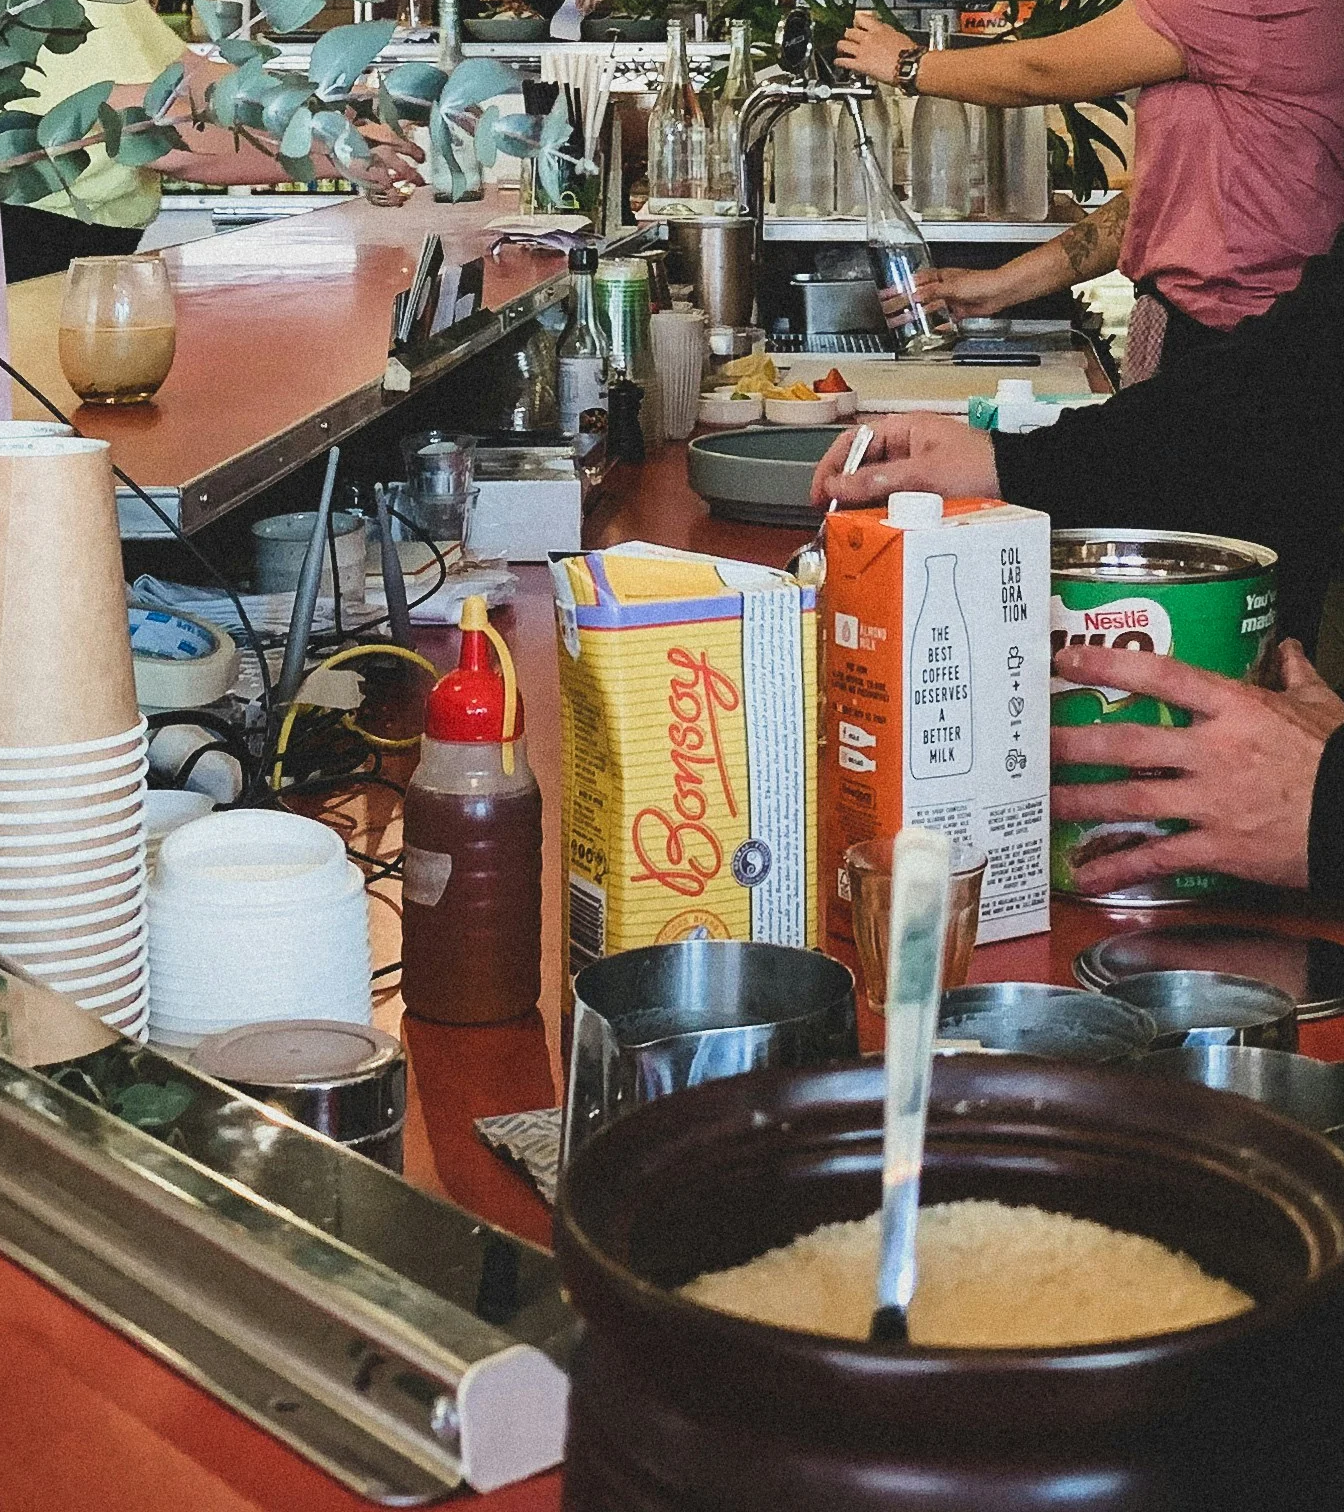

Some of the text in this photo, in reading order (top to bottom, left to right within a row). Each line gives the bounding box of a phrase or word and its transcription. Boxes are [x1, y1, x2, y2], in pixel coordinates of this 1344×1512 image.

[964, 17, 1007, 29] HAND
[931, 626, 950, 642] THE
[927, 645, 953, 663] BEST
[922, 665, 960, 684] COFFEE
[914, 684, 968, 705] DESERVES
[938, 708, 946, 723] A
[923, 726, 961, 745] BETTER
[929, 747, 956, 765] MILK
[631, 646, 740, 898] Bonsoy
